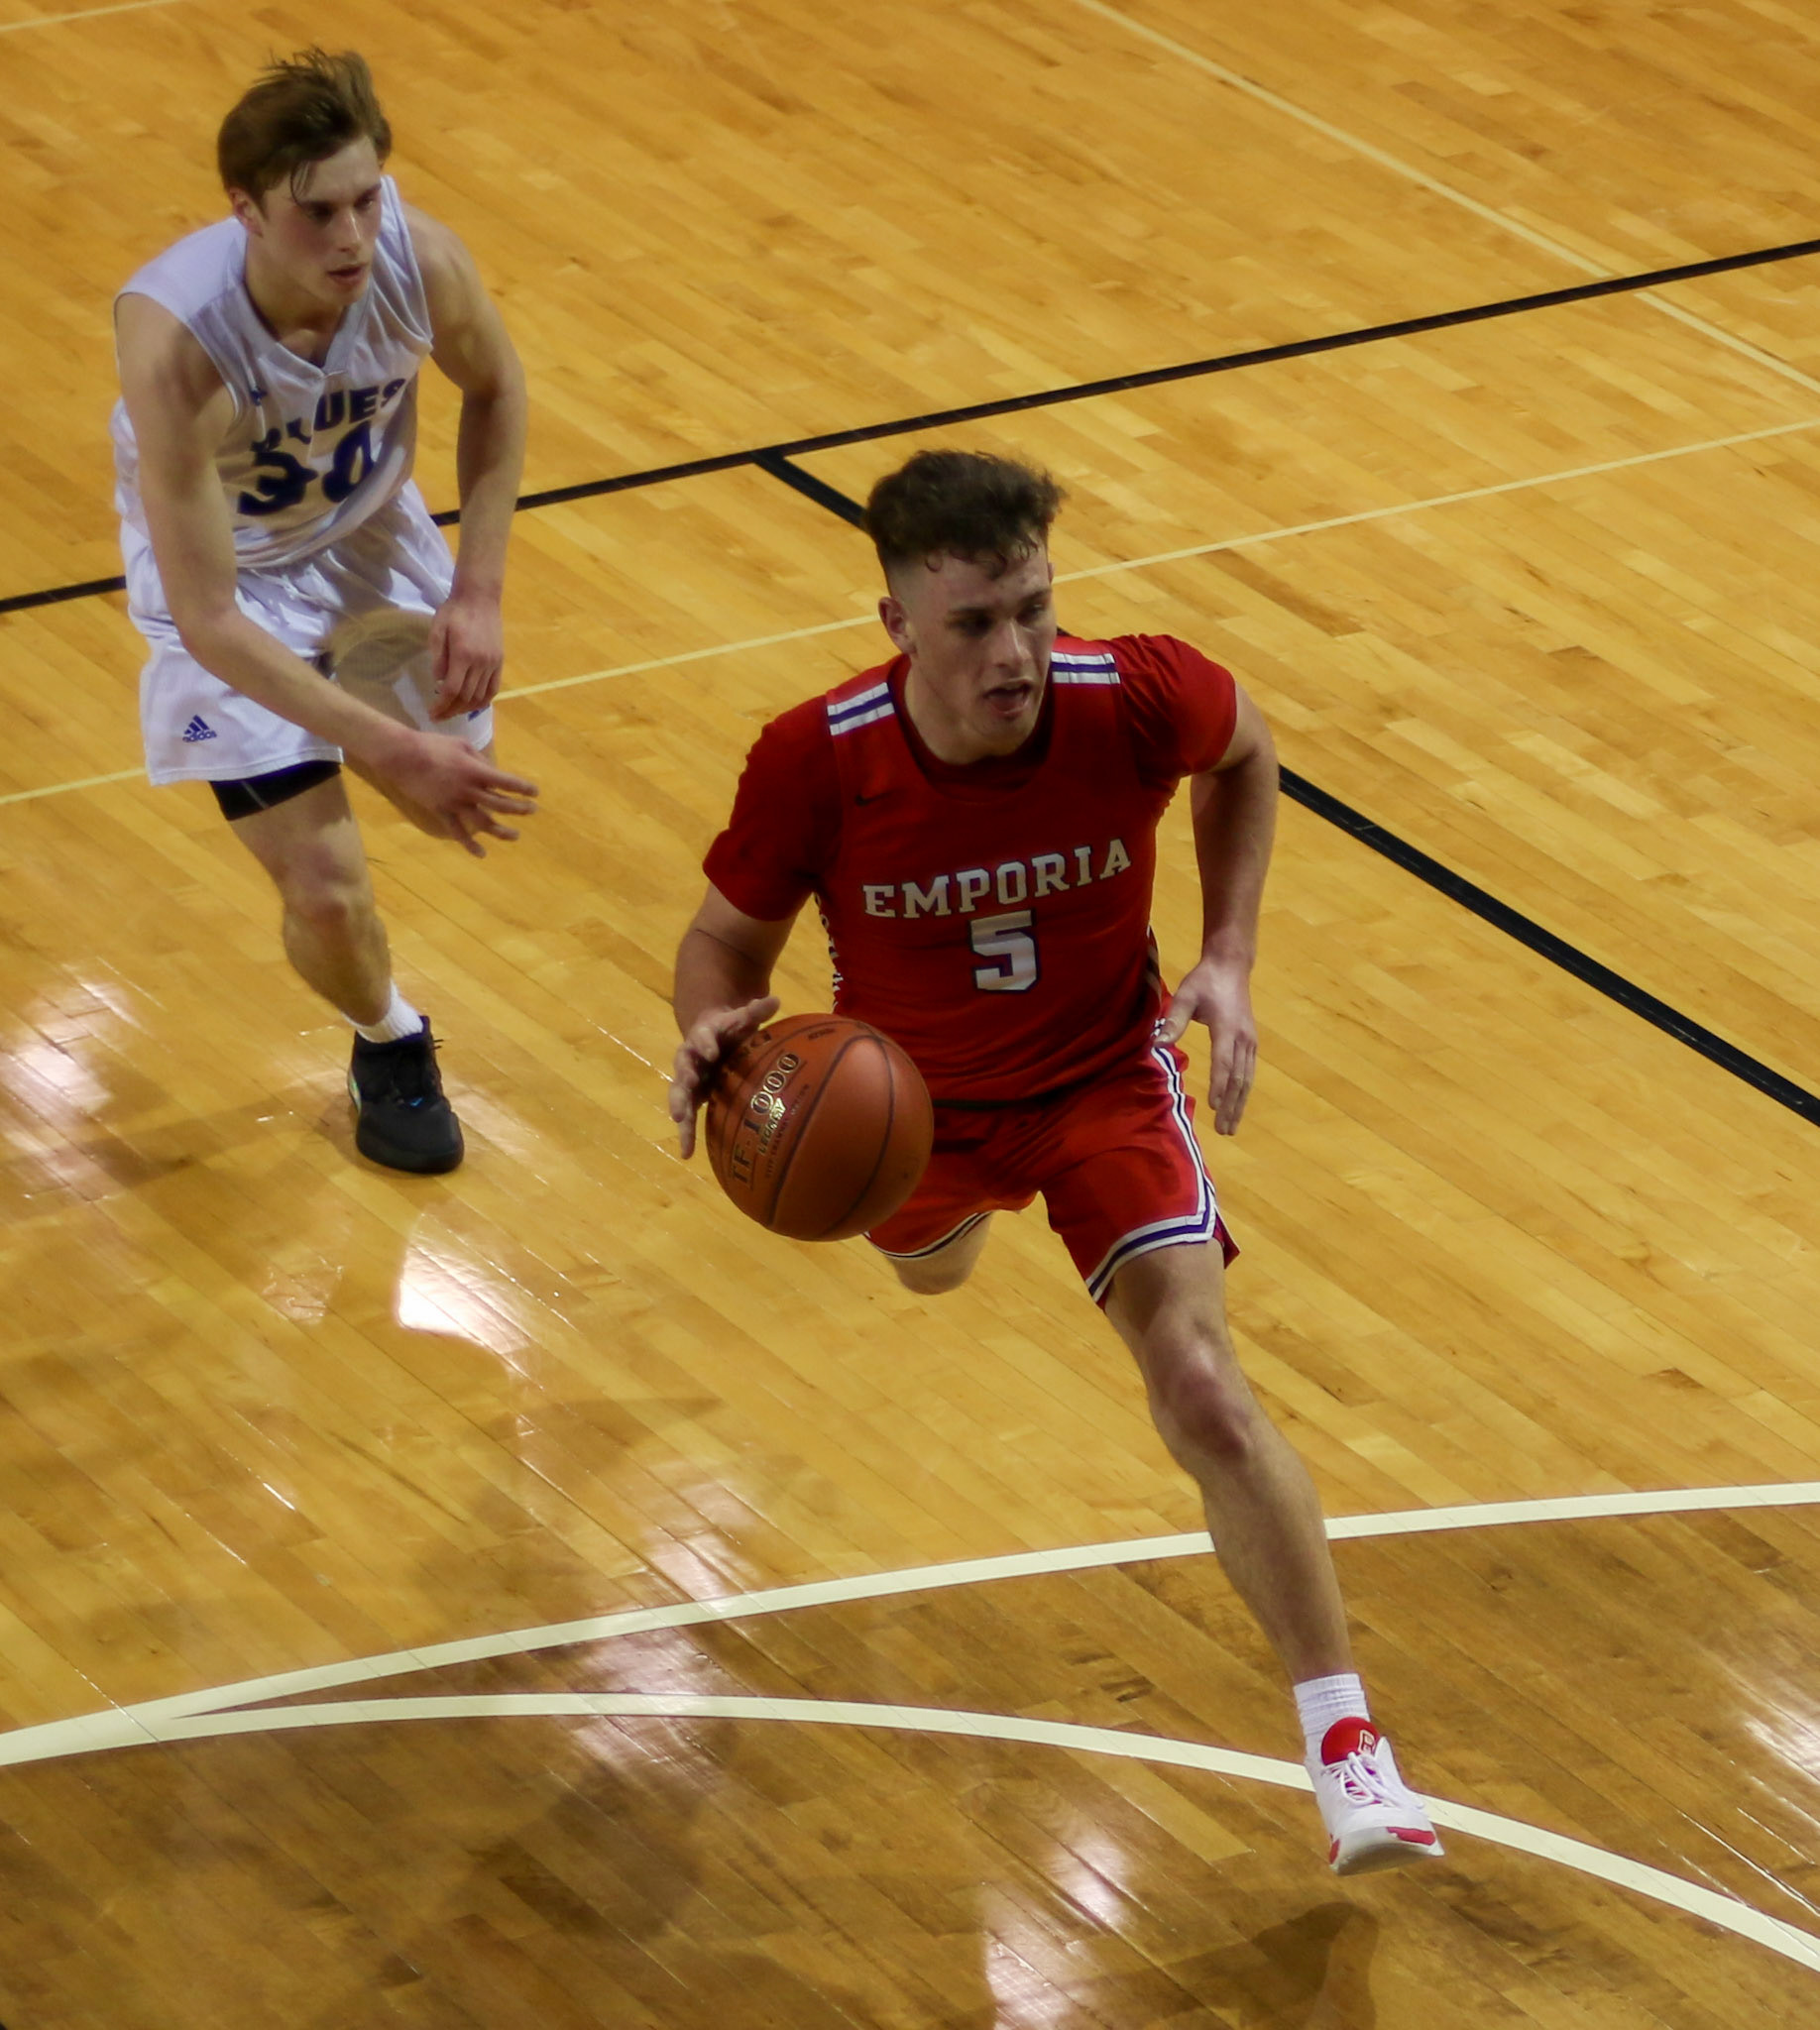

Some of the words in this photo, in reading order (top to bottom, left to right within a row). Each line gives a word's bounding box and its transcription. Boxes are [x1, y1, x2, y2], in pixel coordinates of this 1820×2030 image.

[237, 419, 374, 515] 30
[182, 730, 217, 742] adidas
[861, 838, 1132, 920] EMPORIA
[969, 908, 1039, 992] 5
